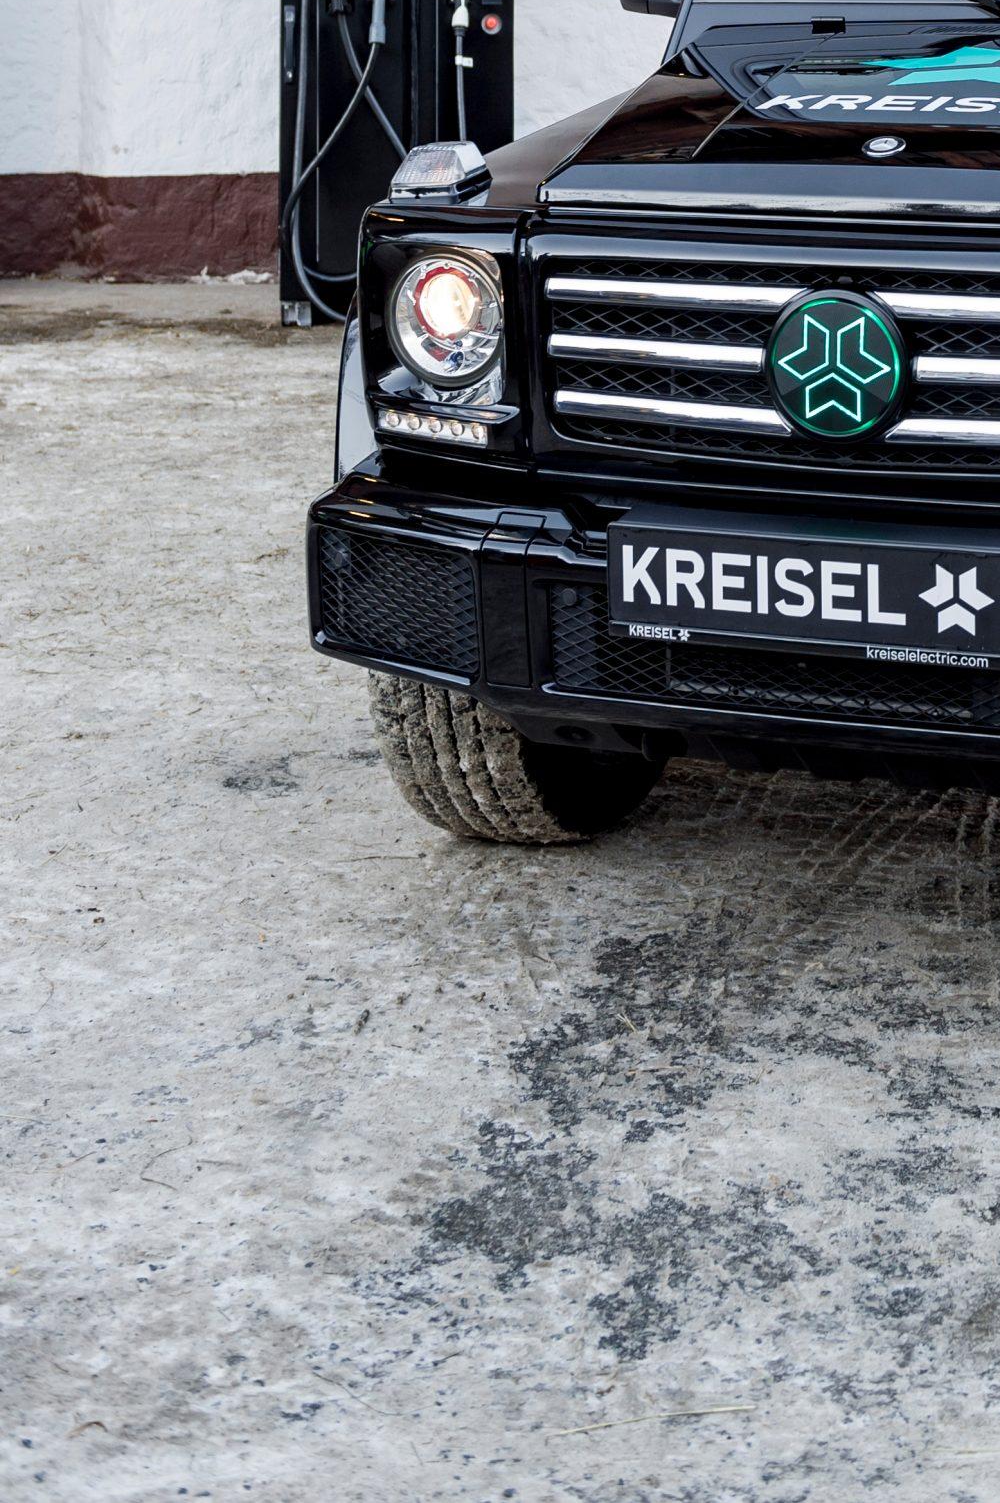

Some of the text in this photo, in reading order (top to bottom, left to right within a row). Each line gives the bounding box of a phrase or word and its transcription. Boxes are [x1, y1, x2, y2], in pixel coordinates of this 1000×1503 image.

[622, 544, 907, 626] KREISEL
[629, 624, 677, 640] KREISEL
[866, 645, 989, 668] kreiselelectric.com
